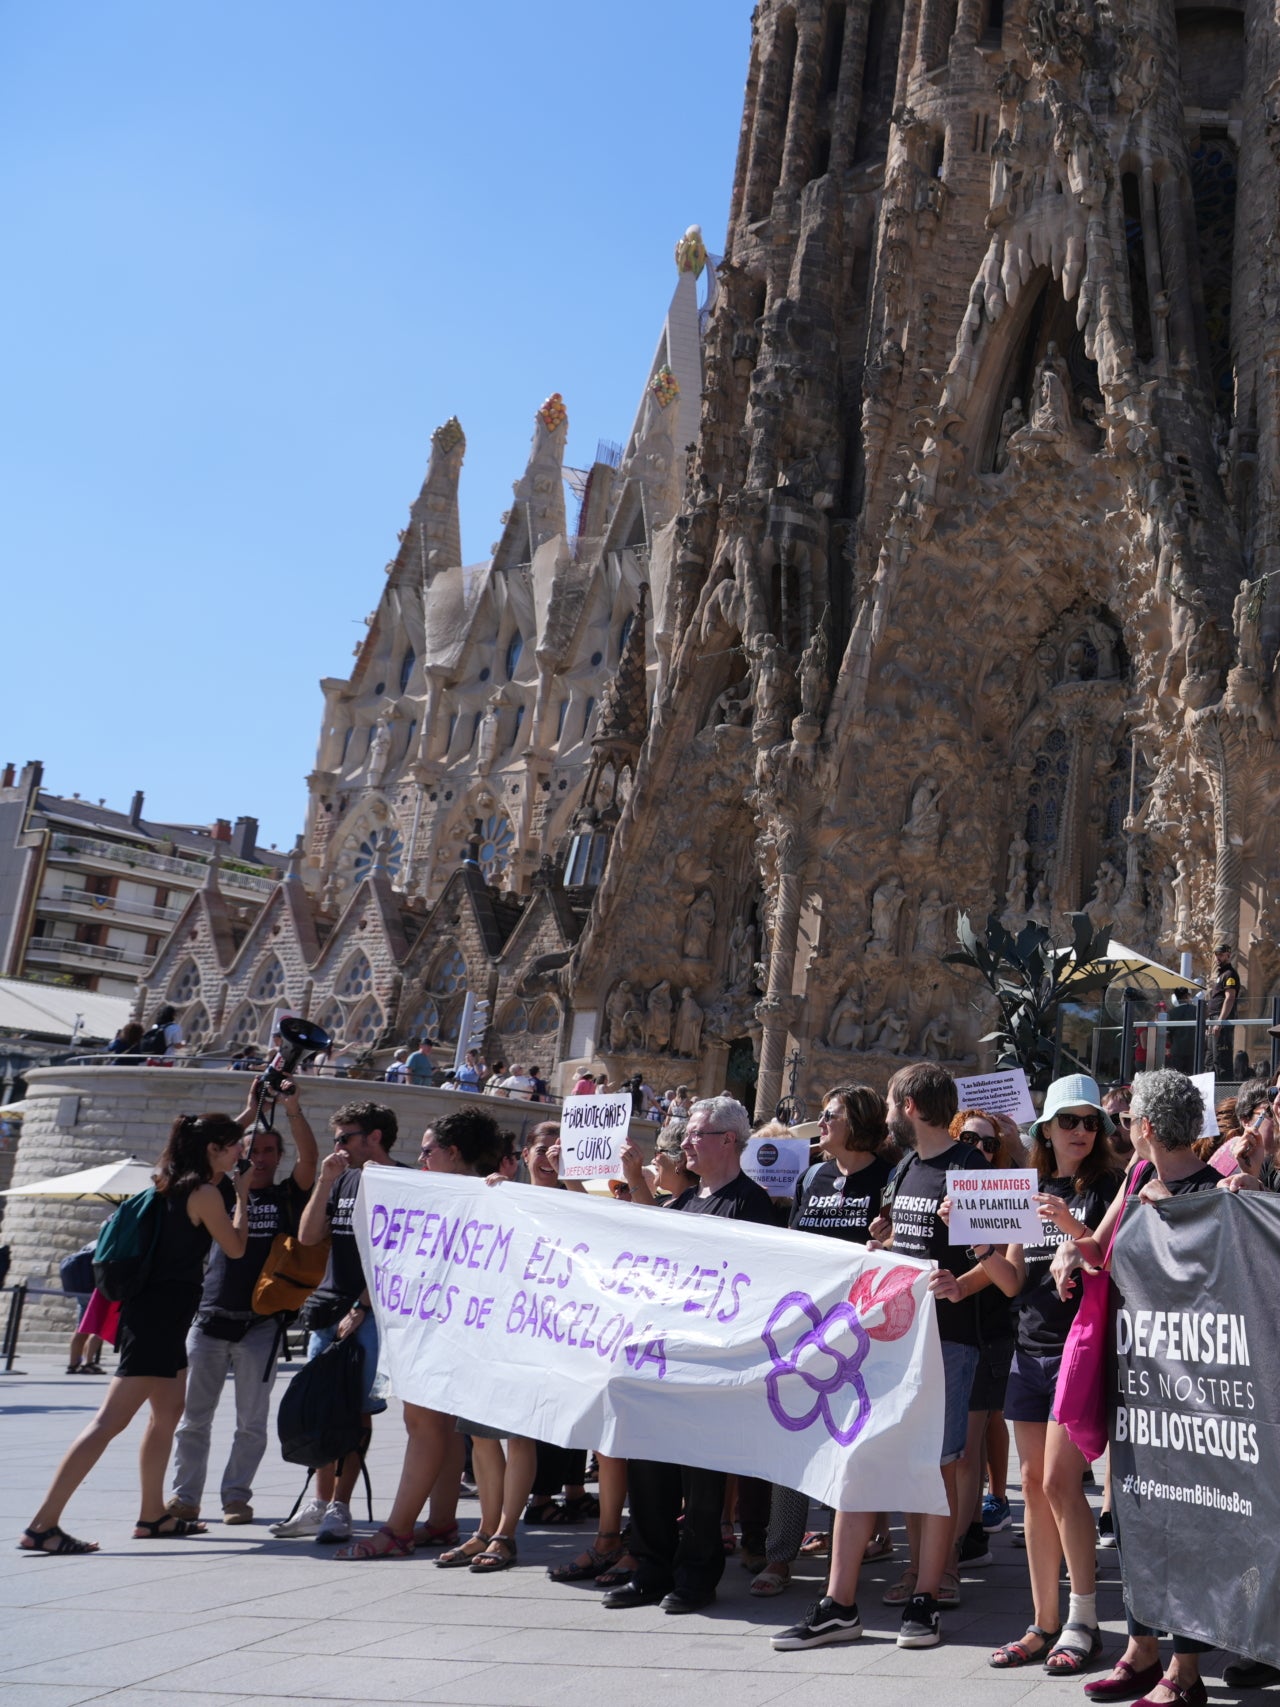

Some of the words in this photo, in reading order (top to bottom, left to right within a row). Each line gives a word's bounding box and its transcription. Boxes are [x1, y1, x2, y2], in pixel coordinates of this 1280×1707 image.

[953, 1179, 978, 1191] PROU
[981, 1178, 1031, 1190] XANTATGES
[804, 1208, 819, 1216] LES
[822, 1208, 868, 1217] NOSTRES
[957, 1199, 964, 1210] A
[965, 1199, 977, 1210] LA
[979, 1198, 1030, 1210] PLANTILLA
[799, 1217, 868, 1228] BIBLIOTEQUES
[897, 1212, 935, 1225] NOSTRES
[970, 1217, 1022, 1229] MUNICIPAL
[371, 1204, 515, 1274] DEFENSEM
[523, 1236, 590, 1289] ELS
[464, 1296, 495, 1329] DE
[505, 1290, 667, 1379] BARCELONA
[1116, 1309, 1250, 1366] DEFENSEM
[1117, 1369, 1150, 1397] LES
[1159, 1373, 1255, 1410] NOSTRES
[1115, 1406, 1260, 1465] BIBLIOTEQUES
[1122, 1474, 1253, 1516] #defensemBibliosBcn
